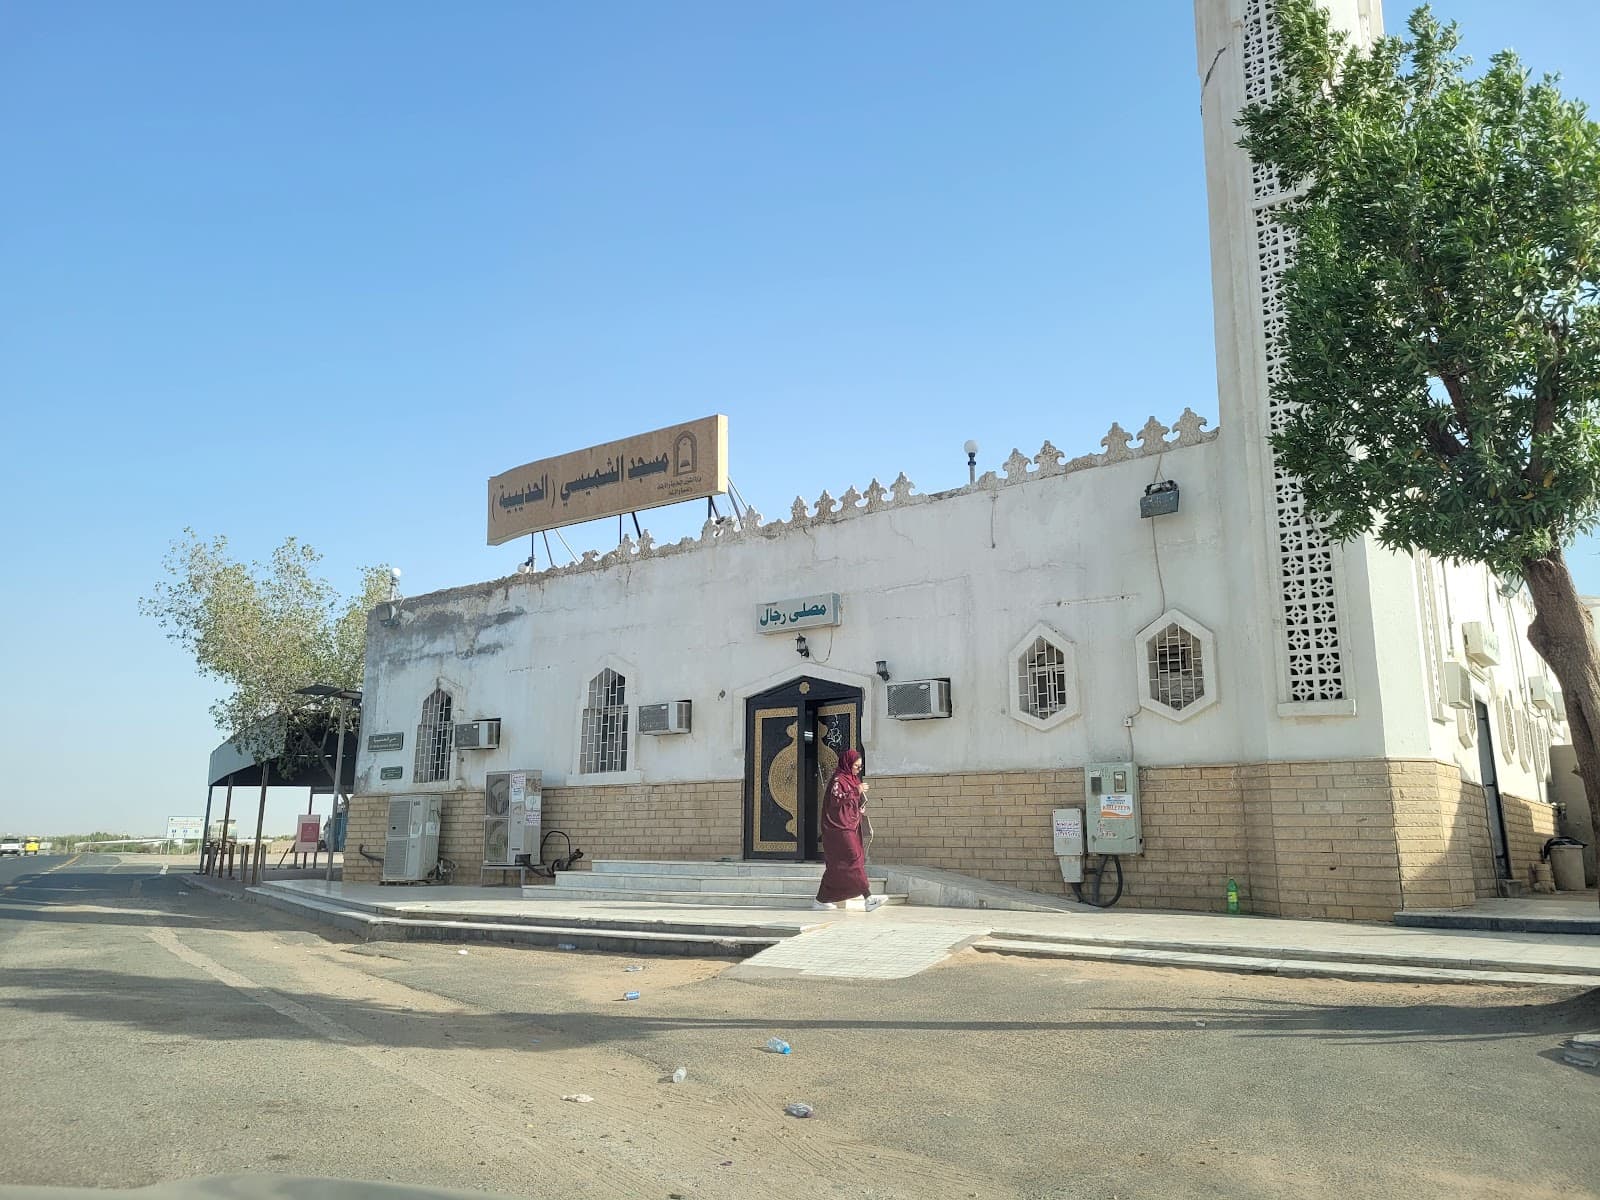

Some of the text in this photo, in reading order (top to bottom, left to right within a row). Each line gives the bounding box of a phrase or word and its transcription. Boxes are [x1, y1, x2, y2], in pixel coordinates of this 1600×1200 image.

[560, 453, 624, 506] الشميسي
[628, 452, 669, 483] مسجد
[760, 602, 826, 626] مصلى رجال
